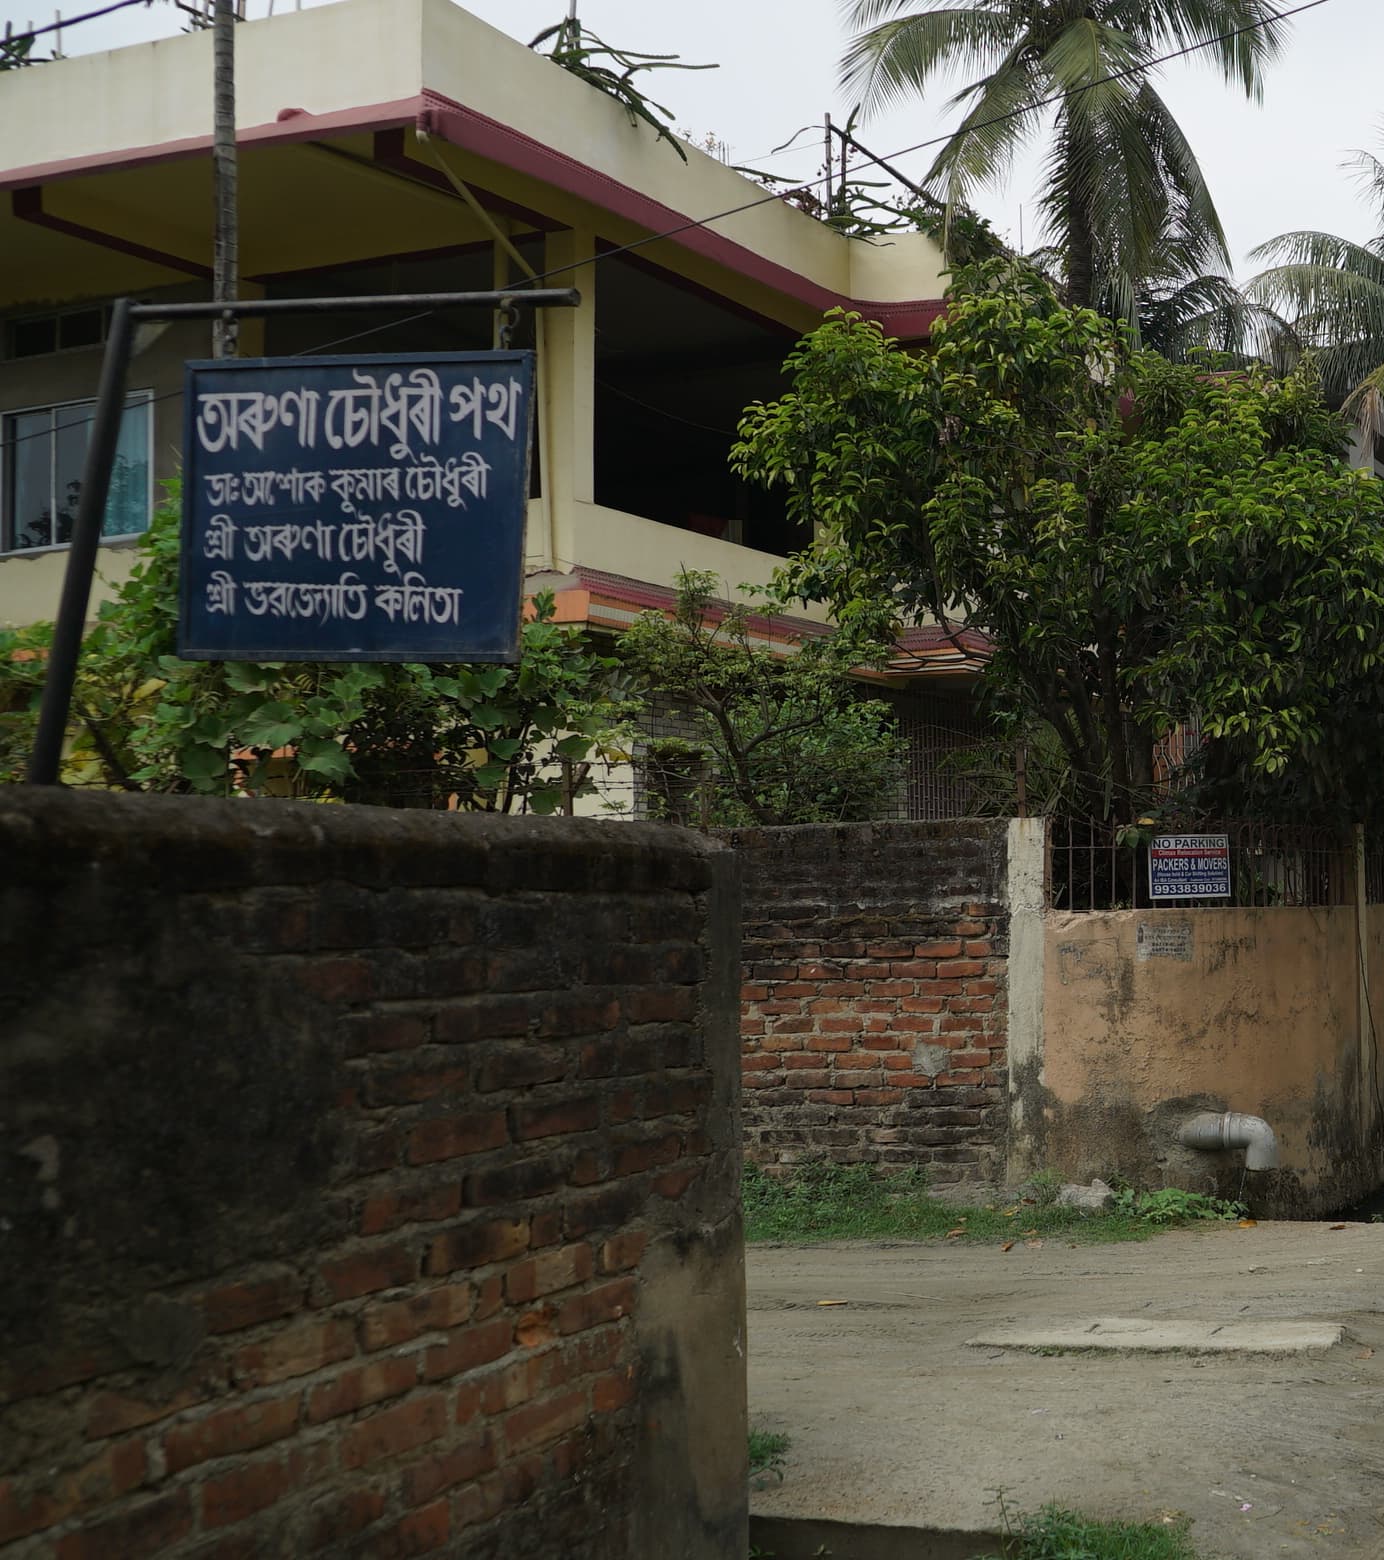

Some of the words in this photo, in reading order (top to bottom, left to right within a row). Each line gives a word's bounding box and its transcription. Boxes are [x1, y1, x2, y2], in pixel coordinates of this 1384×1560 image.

[197, 387, 320, 453] অৰুণা
[325, 368, 443, 464] চৌধুৰী
[449, 376, 523, 441] পথ
[329, 467, 400, 514] কুমাৰ
[405, 452, 491, 511] চৌধুৰী
[204, 514, 240, 561] শ্ৰী
[244, 519, 337, 562] অৰুণা
[338, 509, 427, 575] চৌধুৰী
[205, 570, 240, 616] শ্ৰী
[374, 571, 464, 626] কলিতা
[1152, 858, 1189, 871] PACKERS
[1190, 858, 1196, 870] &
[1197, 857, 1227, 870] MOVERS
[1153, 839, 1171, 849] NO
[1175, 839, 1225, 848] PARKING
[1154, 884, 1226, 894] 9933839036
